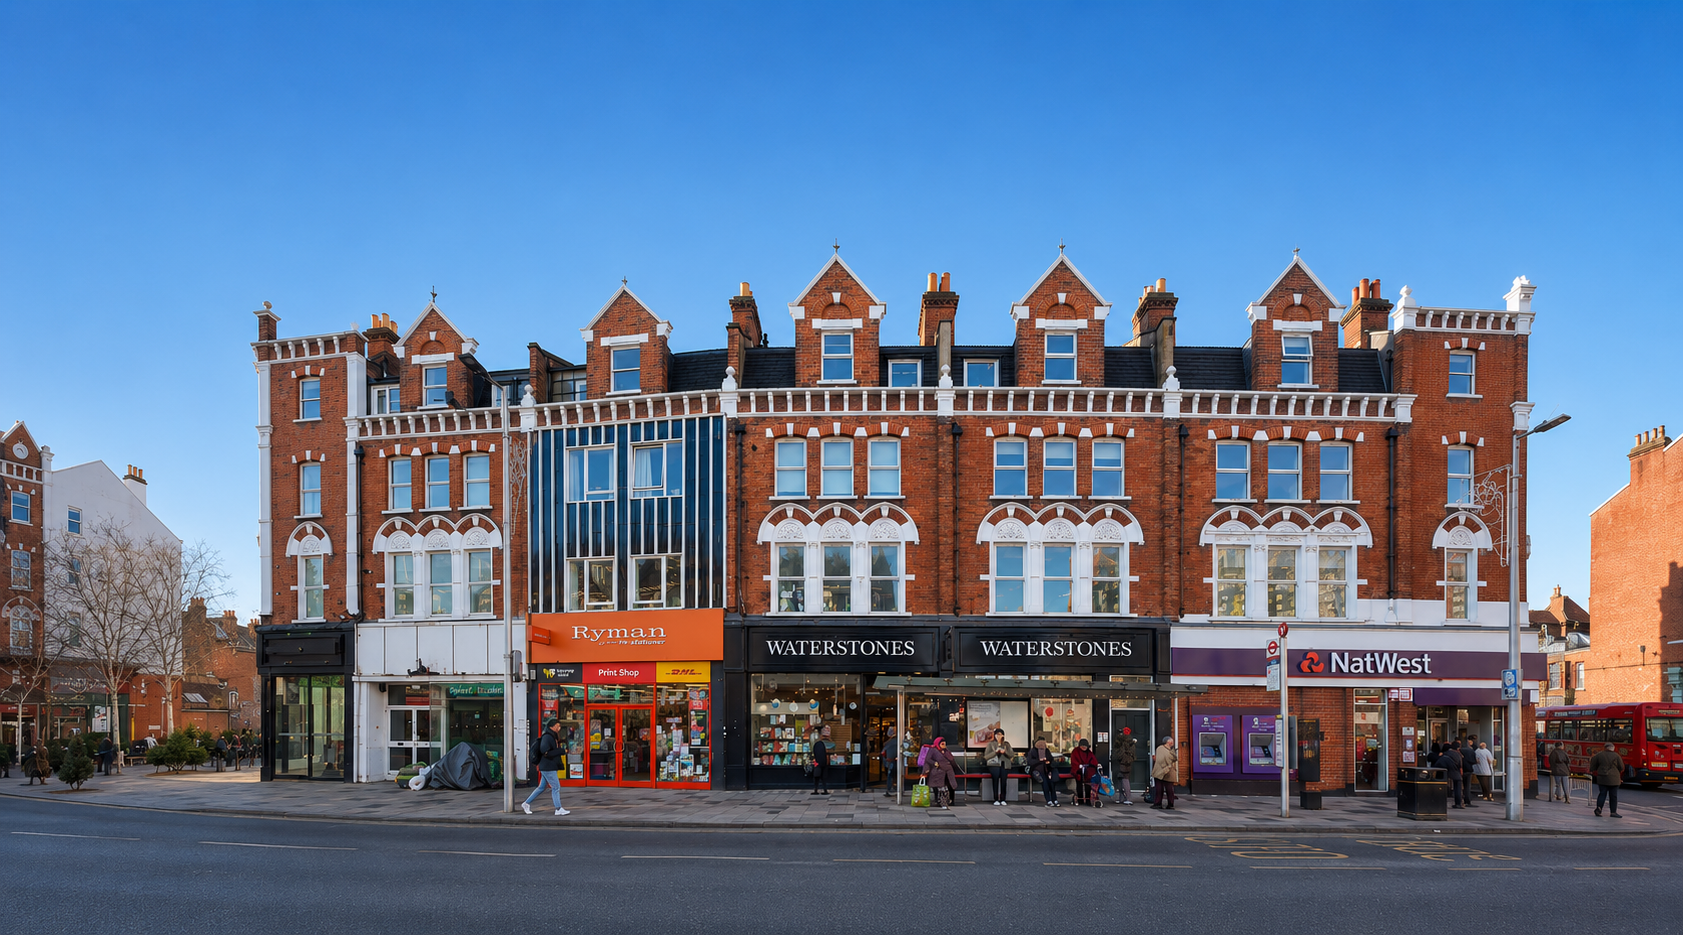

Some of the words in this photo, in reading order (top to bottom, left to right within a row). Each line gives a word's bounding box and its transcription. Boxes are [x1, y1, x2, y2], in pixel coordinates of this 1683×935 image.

[572, 626, 667, 642] Ryman
[766, 640, 915, 656] WATERSTONES
[980, 641, 1132, 657] WATERSTONES
[1330, 652, 1432, 674] NatWest
[598, 668, 618, 677] Print
[619, 668, 640, 678] Shop
